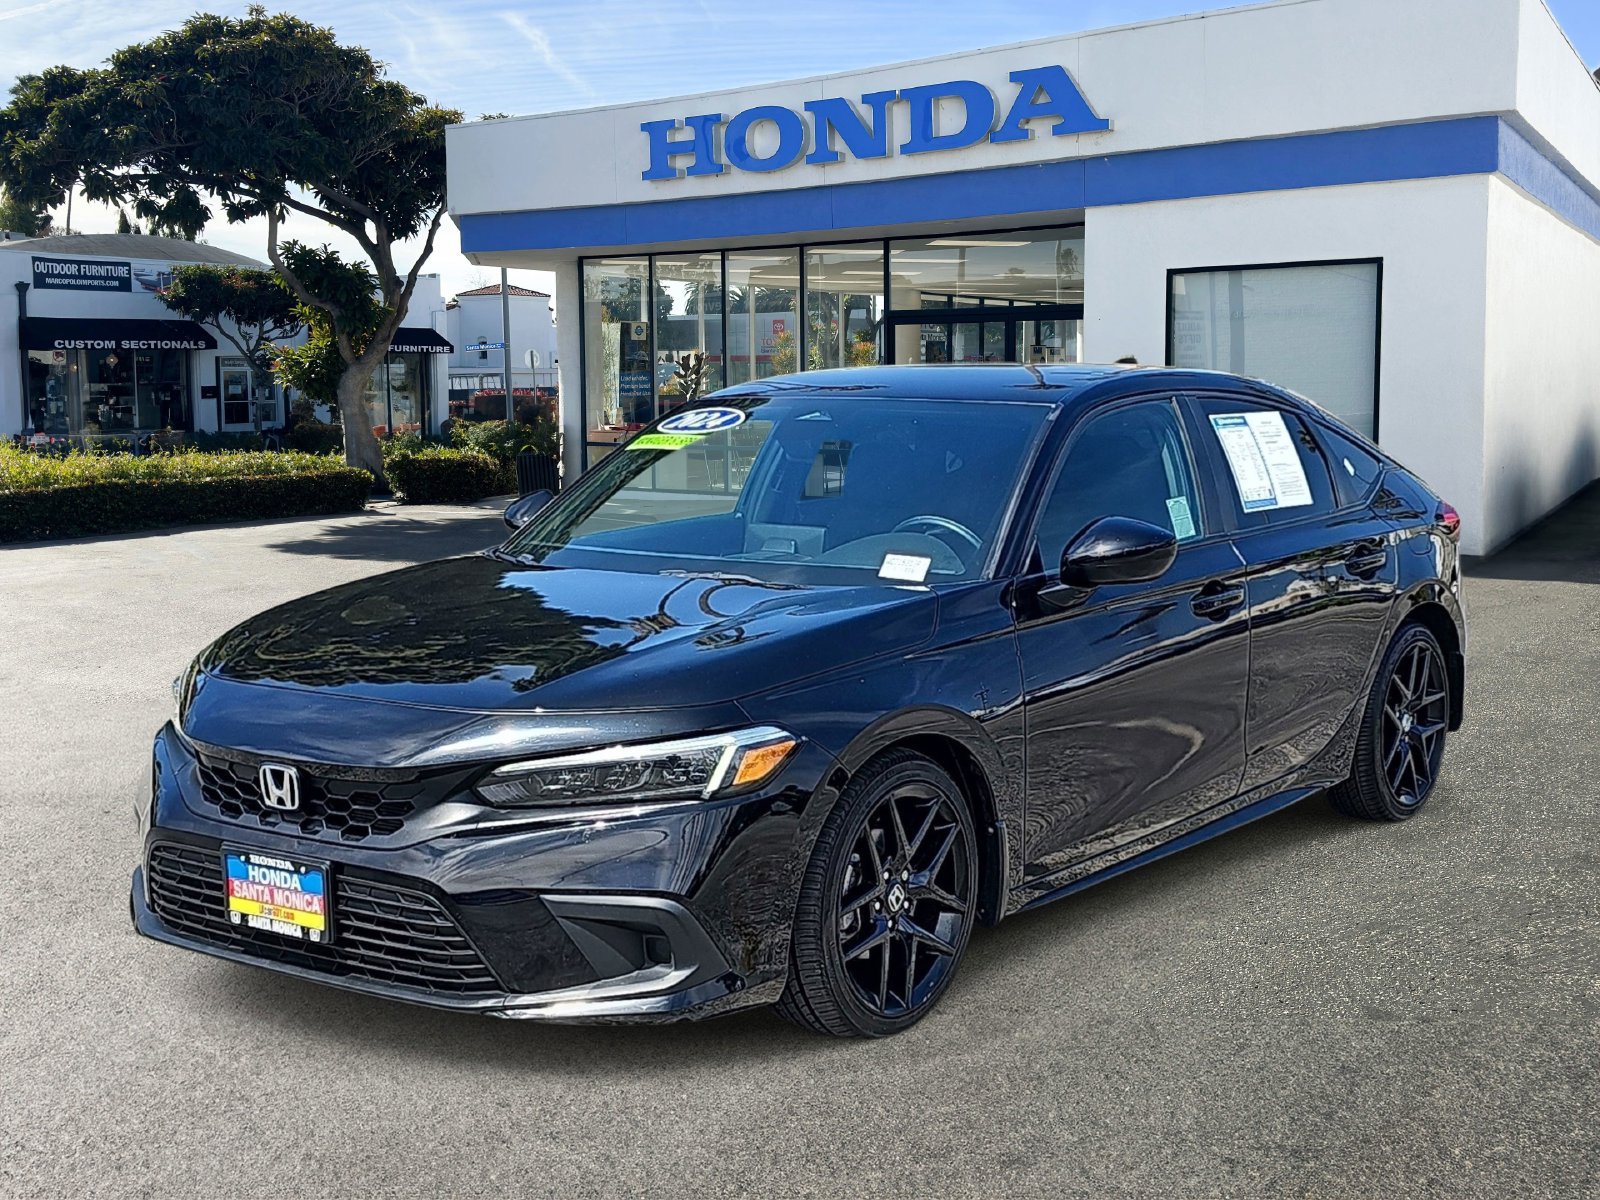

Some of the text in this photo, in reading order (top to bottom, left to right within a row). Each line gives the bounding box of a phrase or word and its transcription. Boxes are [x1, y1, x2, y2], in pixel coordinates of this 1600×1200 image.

[640, 65, 1111, 182] HONDA
[34, 261, 130, 278] OUTDOOR FURNITURE
[54, 339, 206, 349] CUSTOM SECTIONALS
[388, 344, 451, 353] FURNITURE
[248, 865, 302, 892] HONDA
[233, 880, 272, 905] SANTA
[274, 888, 321, 914] MONICA
